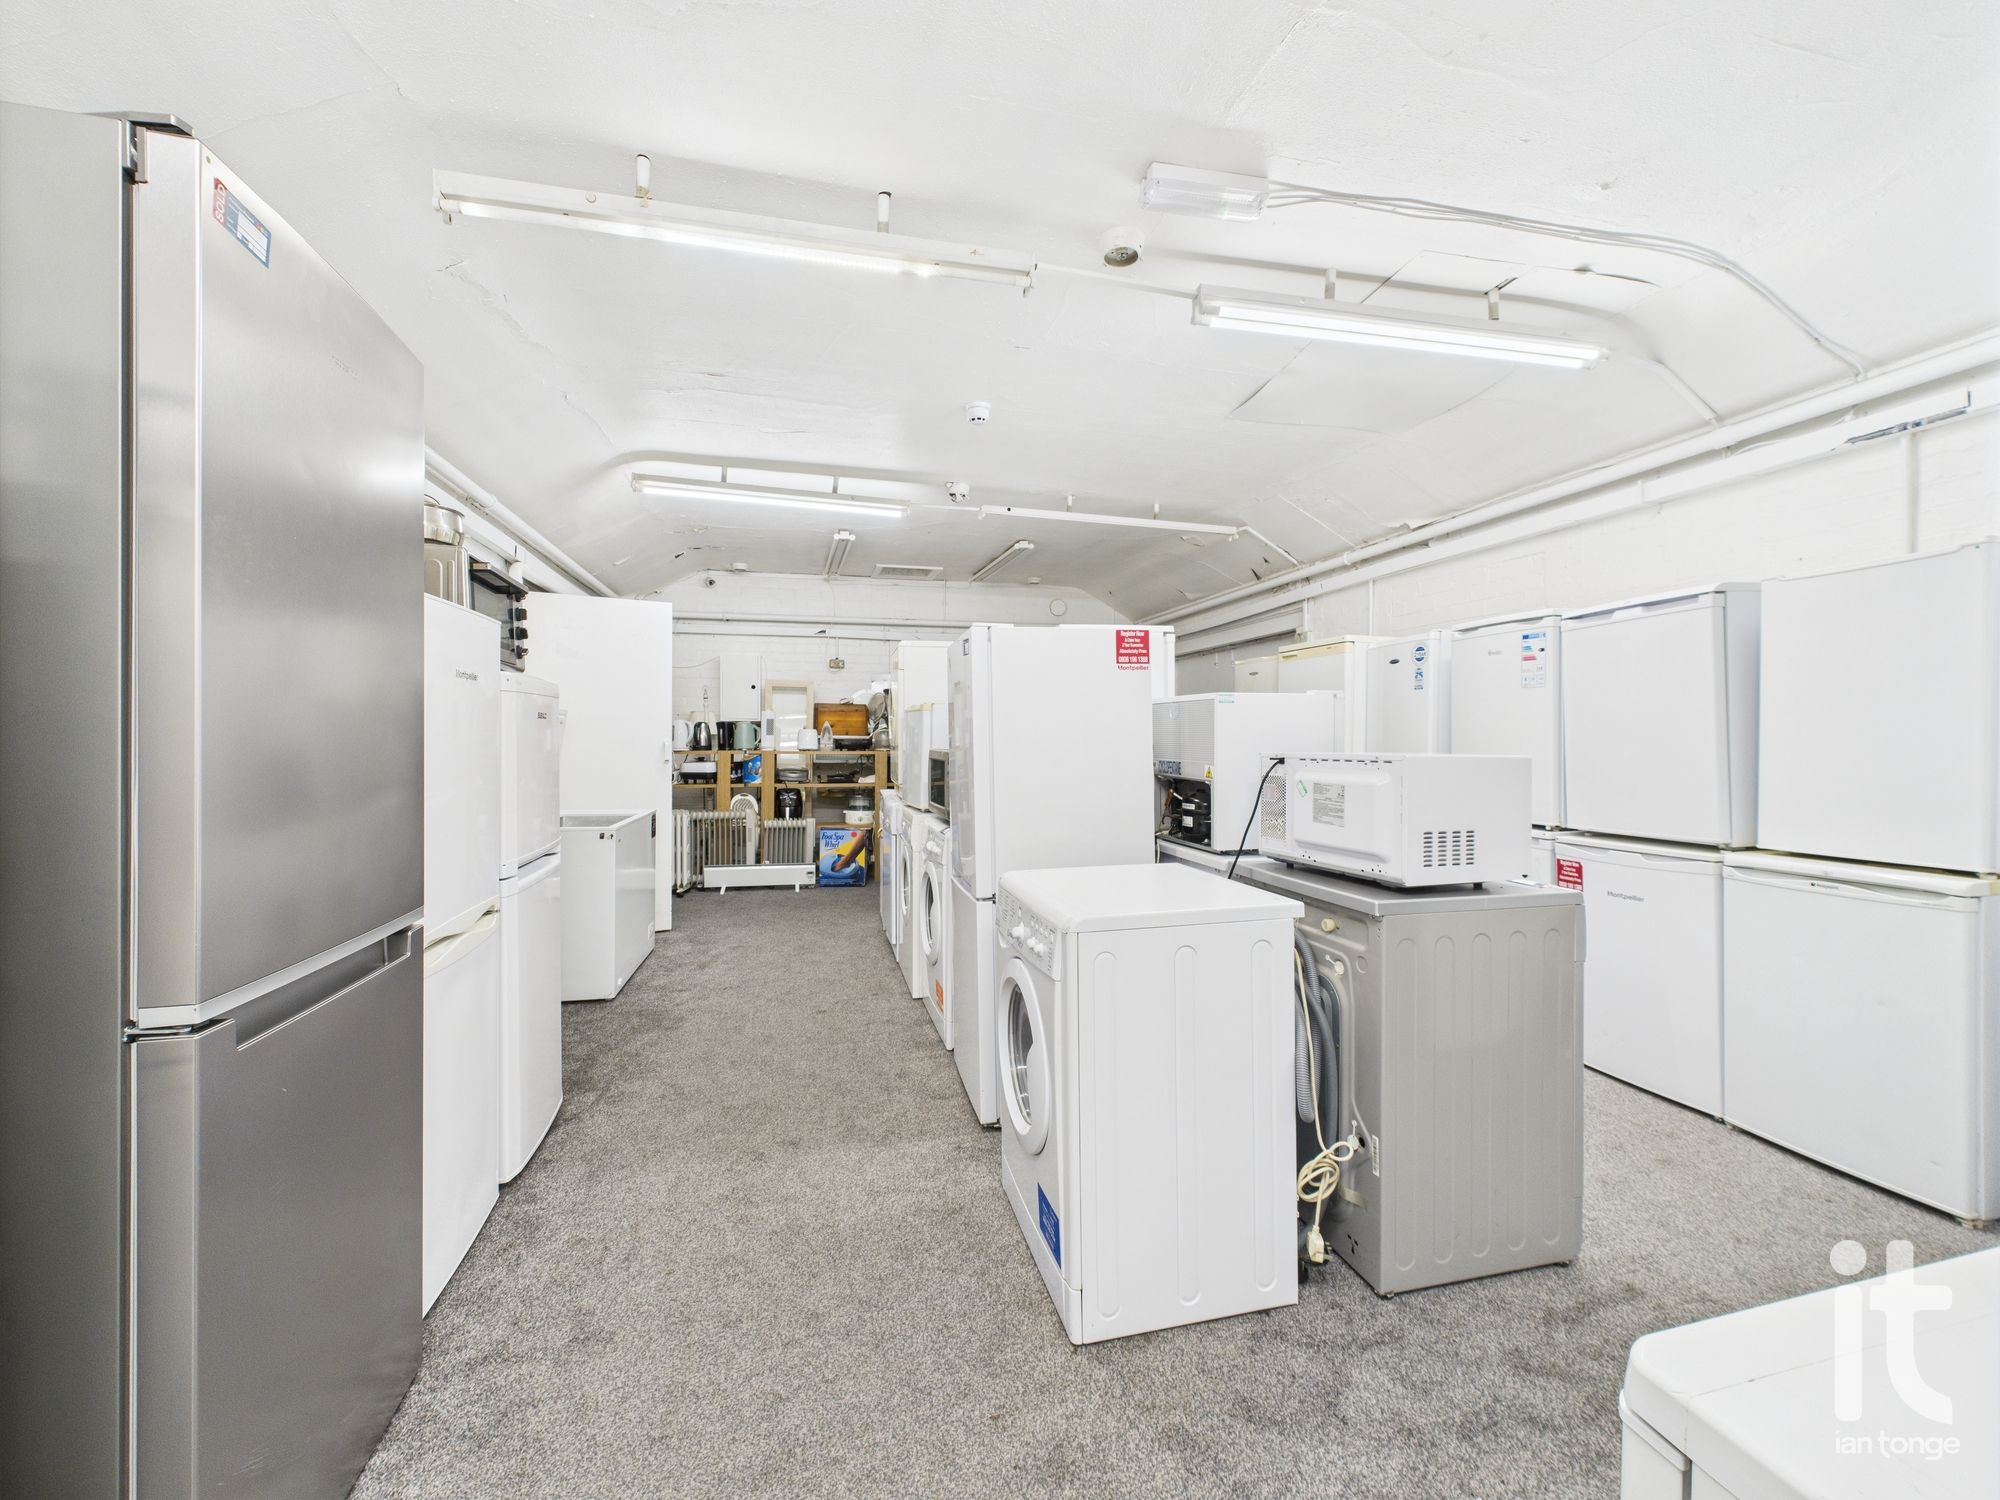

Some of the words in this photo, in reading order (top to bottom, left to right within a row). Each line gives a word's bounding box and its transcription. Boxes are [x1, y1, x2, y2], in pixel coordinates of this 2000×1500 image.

[215, 183, 226, 224] SOLD
[822, 831, 833, 840] Foot
[834, 832, 845, 842] Spa
[824, 839, 840, 848] Whirl
